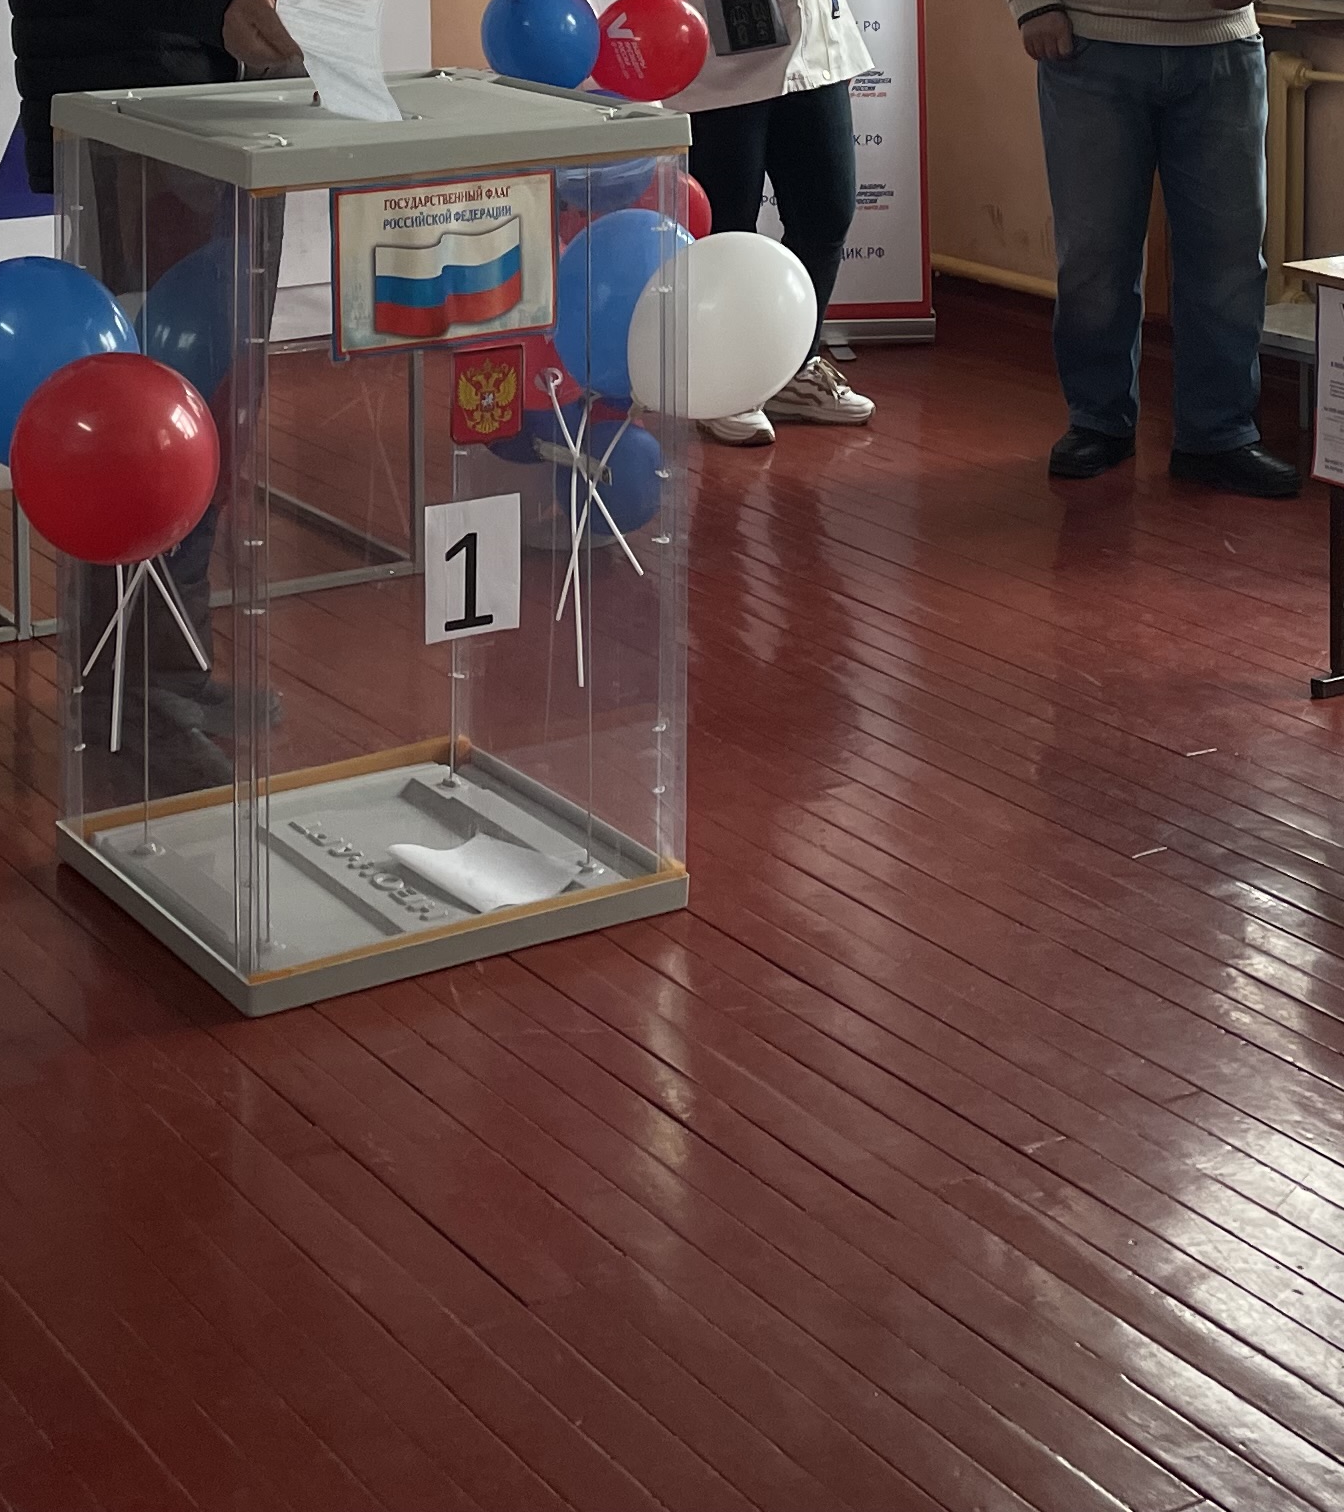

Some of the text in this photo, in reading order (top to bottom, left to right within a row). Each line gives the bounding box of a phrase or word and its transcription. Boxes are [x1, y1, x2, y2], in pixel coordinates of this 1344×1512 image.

[853, 134, 883, 146] К.РФ
[383, 186, 511, 211] ГОСУДАРСТВЕННЫЙ ФЛАГ
[383, 205, 512, 231] РОССИЙСКОЙ ФЕДЕРАЦИИ
[443, 532, 494, 632] 1
